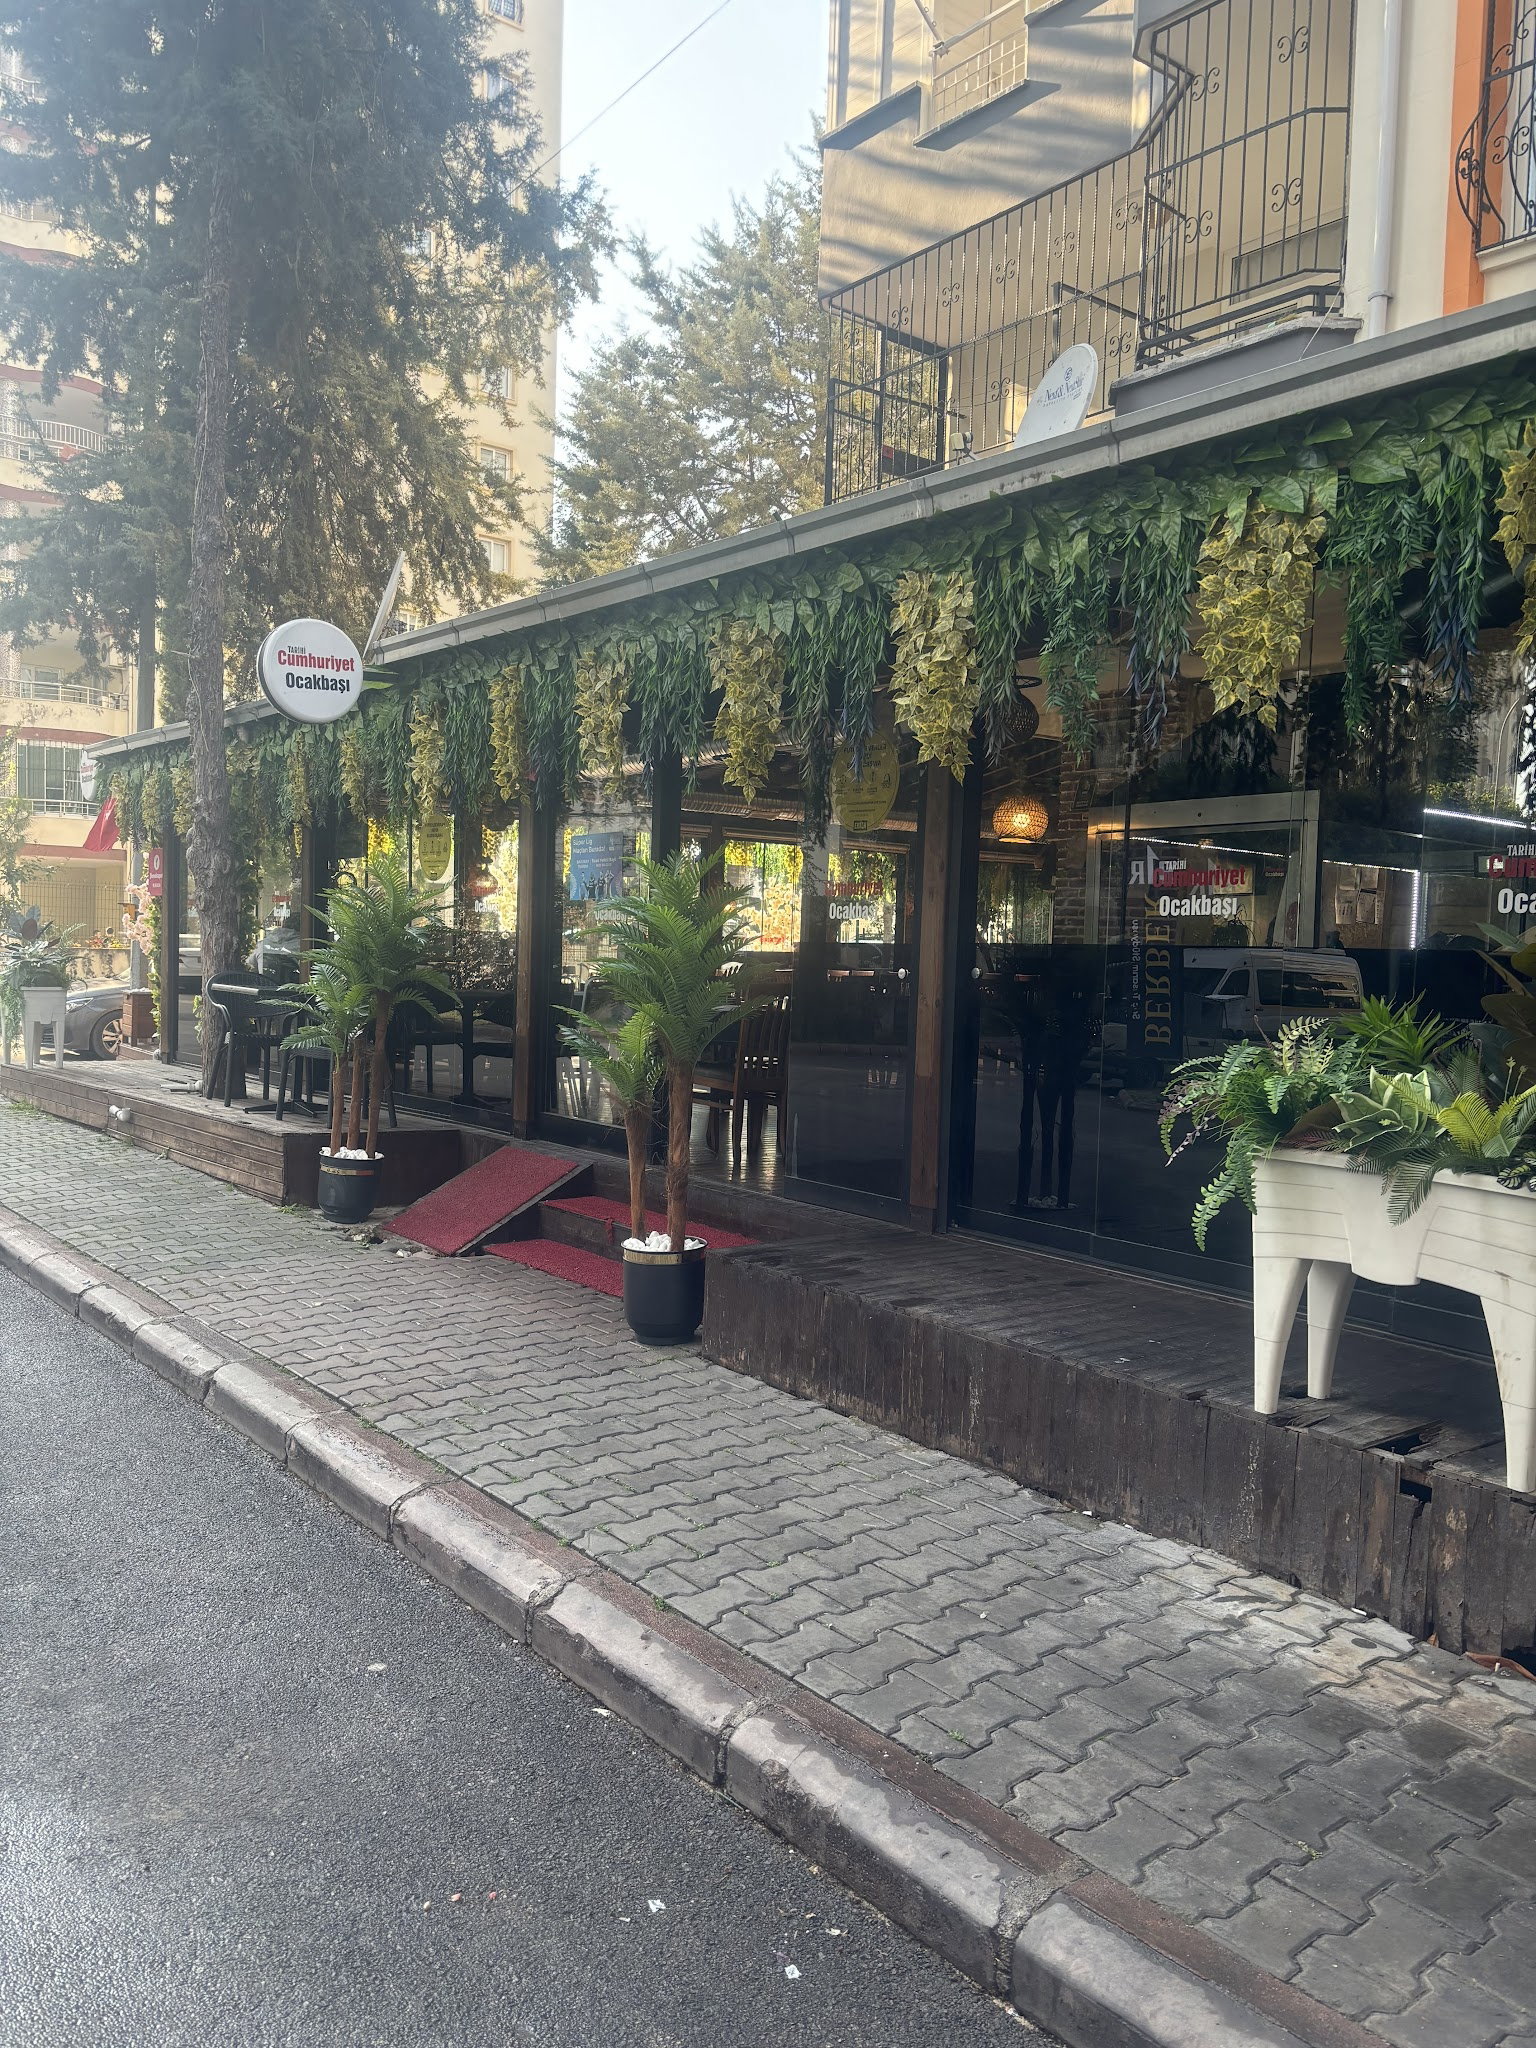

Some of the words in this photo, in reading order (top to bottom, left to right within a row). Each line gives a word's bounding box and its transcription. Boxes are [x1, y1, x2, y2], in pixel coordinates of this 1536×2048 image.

[278, 650, 354, 672] Cumhuriyet
[286, 672, 350, 693] Ocakbaşı
[1165, 857, 1188, 871] TARİHİ
[1152, 864, 1246, 888] Cumhuriyet
[1158, 894, 1238, 919] Ocakbaşı
